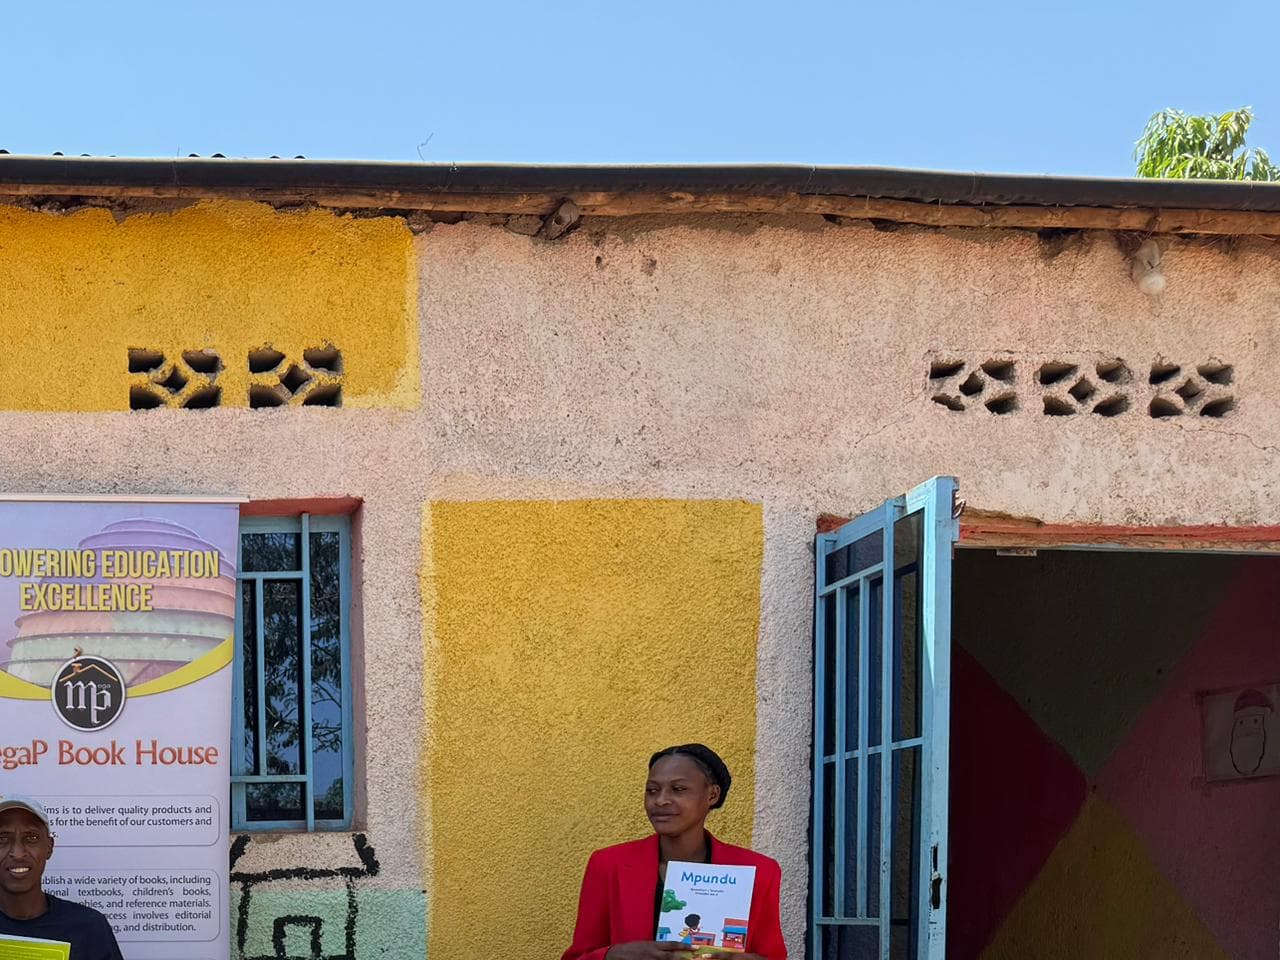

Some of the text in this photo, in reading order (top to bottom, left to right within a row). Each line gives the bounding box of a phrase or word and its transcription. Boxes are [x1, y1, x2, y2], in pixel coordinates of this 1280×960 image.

[101, 550, 220, 579] EDUCATION
[20, 583, 154, 612] EXCELLENCE
[57, 739, 126, 766] Book
[135, 739, 220, 767] House
[62, 806, 70, 815] is
[72, 806, 82, 815] to
[84, 805, 115, 815] deliver
[118, 805, 149, 817] quality
[151, 805, 193, 816] products
[194, 805, 212, 814] and
[55, 817, 68, 826] for
[70, 817, 84, 826] the
[86, 817, 118, 826] benefit
[119, 817, 130, 826] of
[130, 818, 145, 826] our
[147, 817, 194, 826] customers
[195, 817, 212, 826] and
[74, 876, 96, 885] wide
[97, 876, 128, 887] variety
[128, 875, 139, 885] of
[139, 875, 168, 886] books,
[169, 875, 211, 887] including
[680, 871, 737, 886] Mpundu
[78, 887, 124, 898] textbooks,
[132, 887, 174, 897] children's
[182, 887, 212, 897] books,
[106, 899, 123, 908] and
[125, 899, 167, 908] reference
[169, 899, 212, 908] materials.
[132, 911, 169, 920] involves
[175, 911, 212, 920] editorial
[123, 923, 141, 932] and
[142, 922, 197, 932] distribution.
